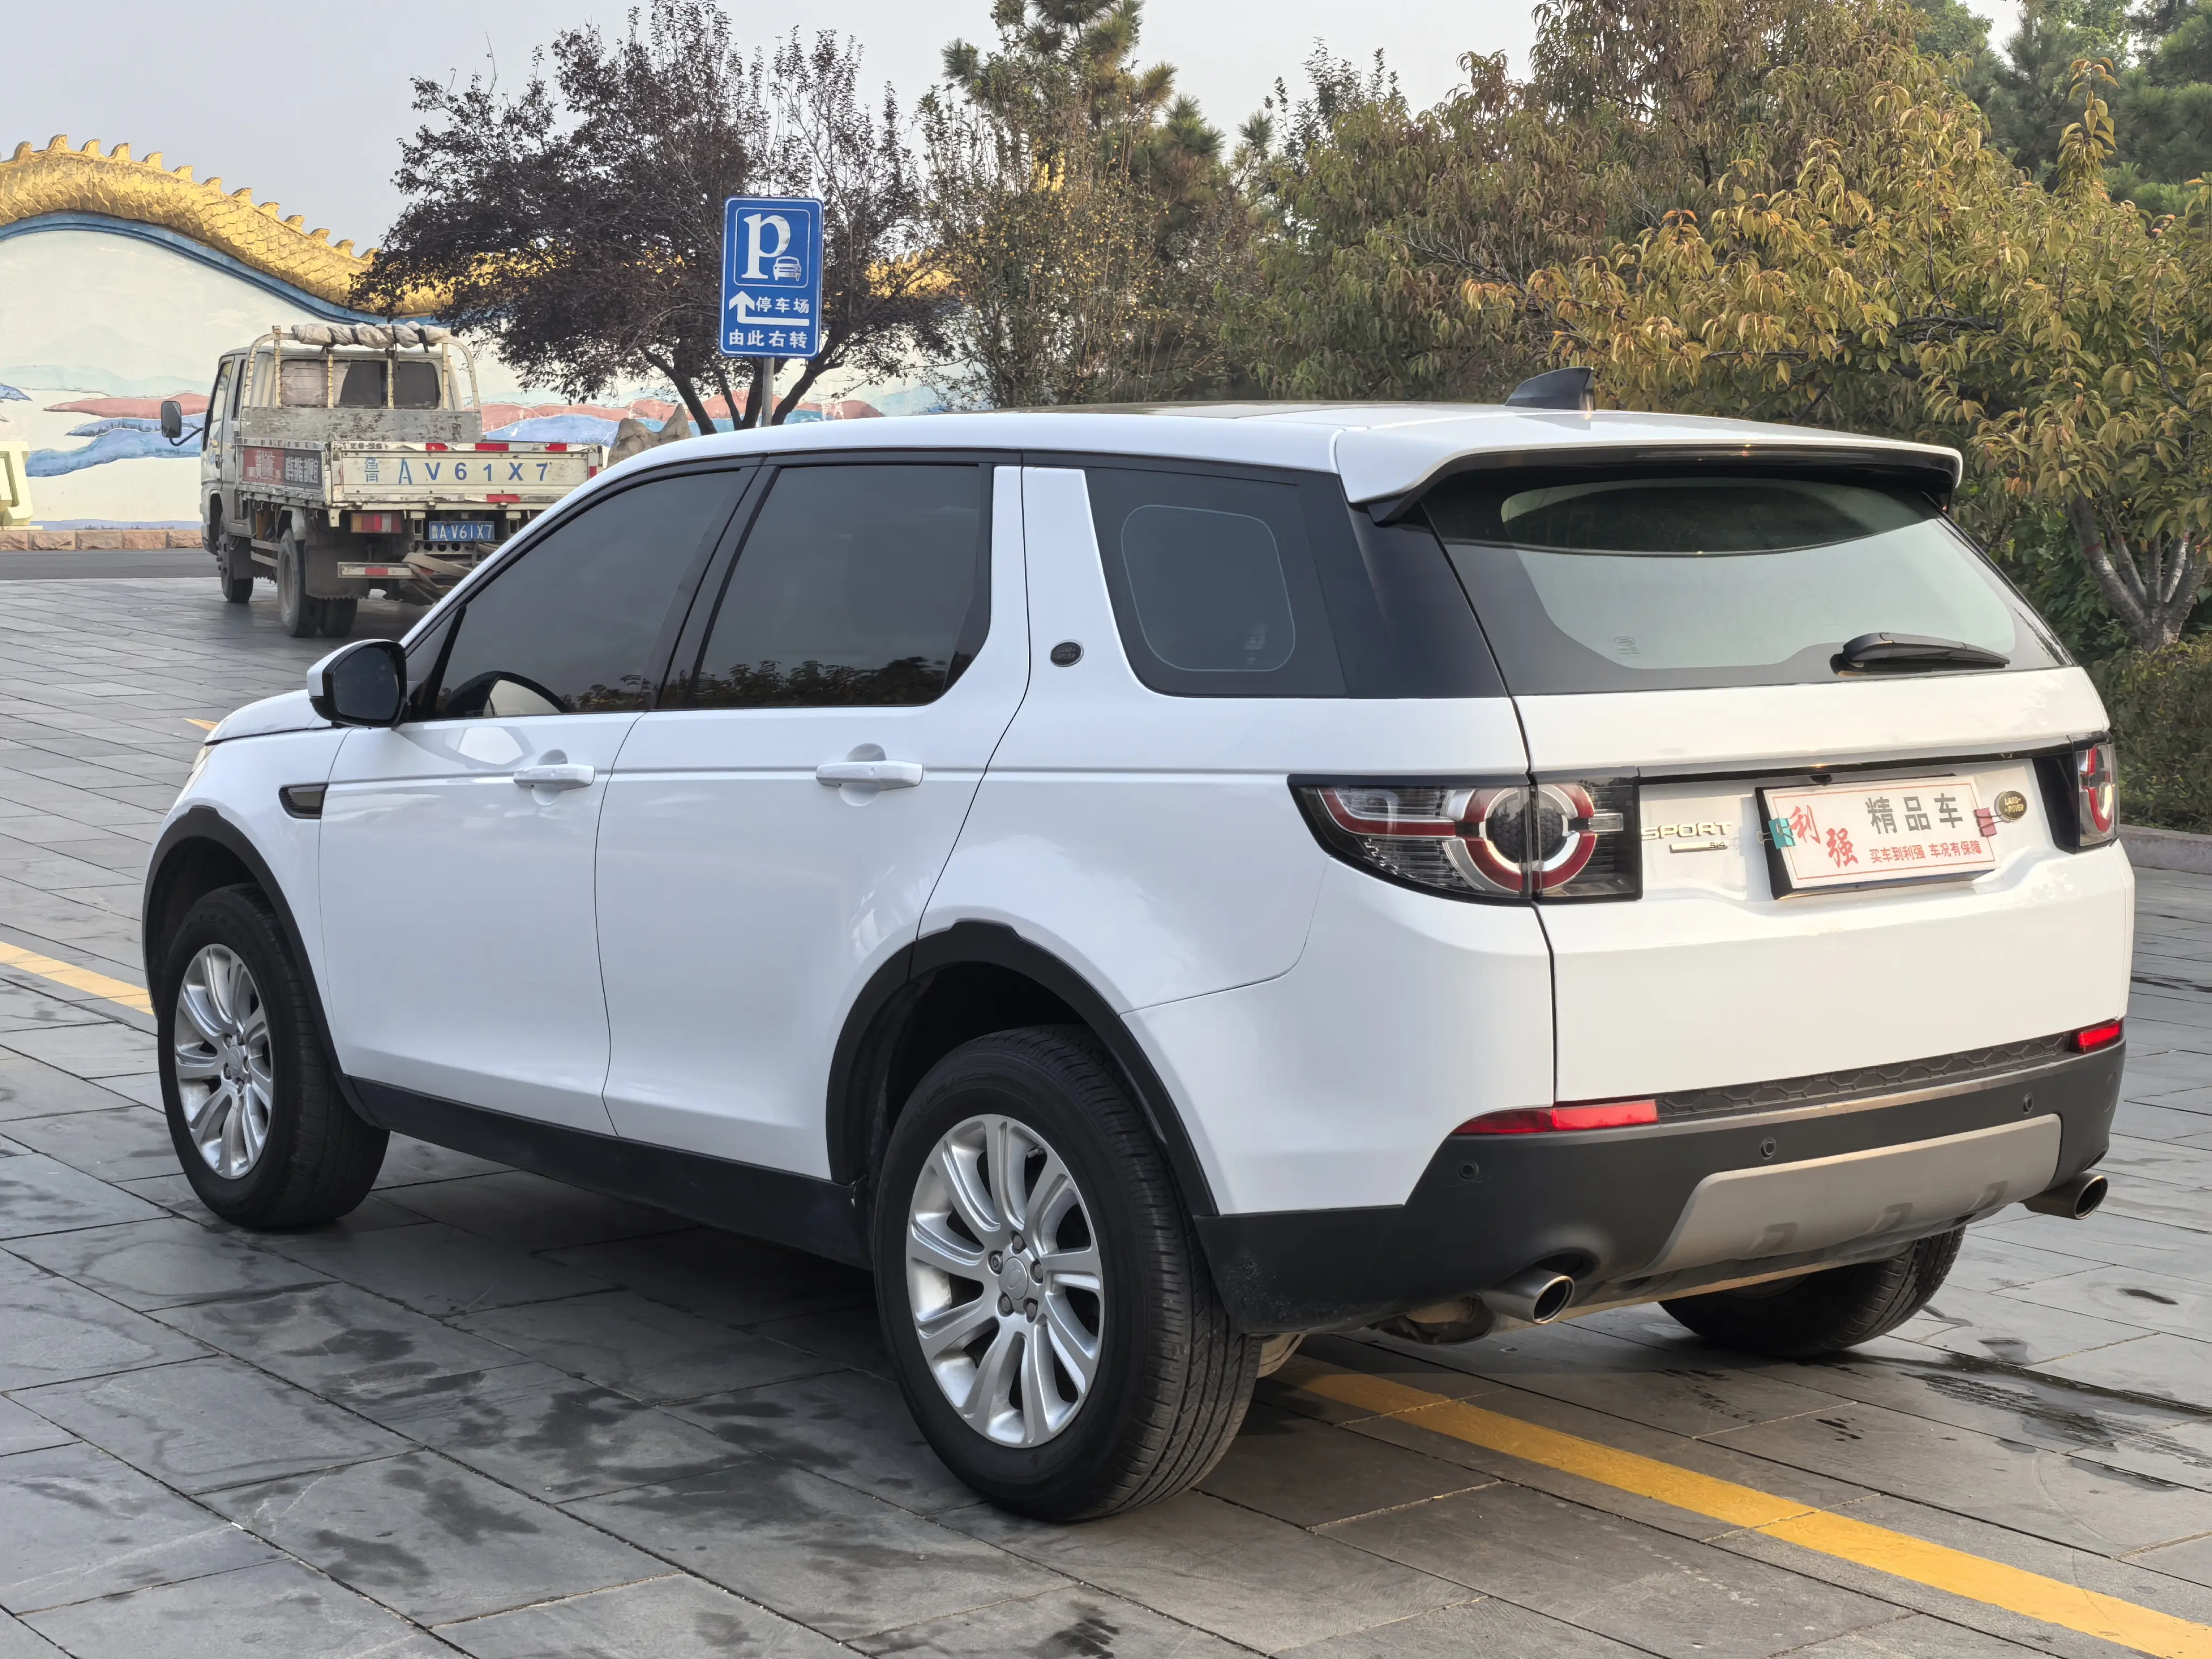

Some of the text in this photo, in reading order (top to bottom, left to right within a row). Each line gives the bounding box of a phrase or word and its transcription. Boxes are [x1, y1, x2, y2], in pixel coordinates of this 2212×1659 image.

[756, 296, 810, 313] 停车场
[729, 329, 808, 348] 由此右转
[1865, 793, 1964, 834] 精品车
[1641, 821, 1734, 841] SPORT
[1869, 840, 1982, 864] 买车到利强 车况有保障
